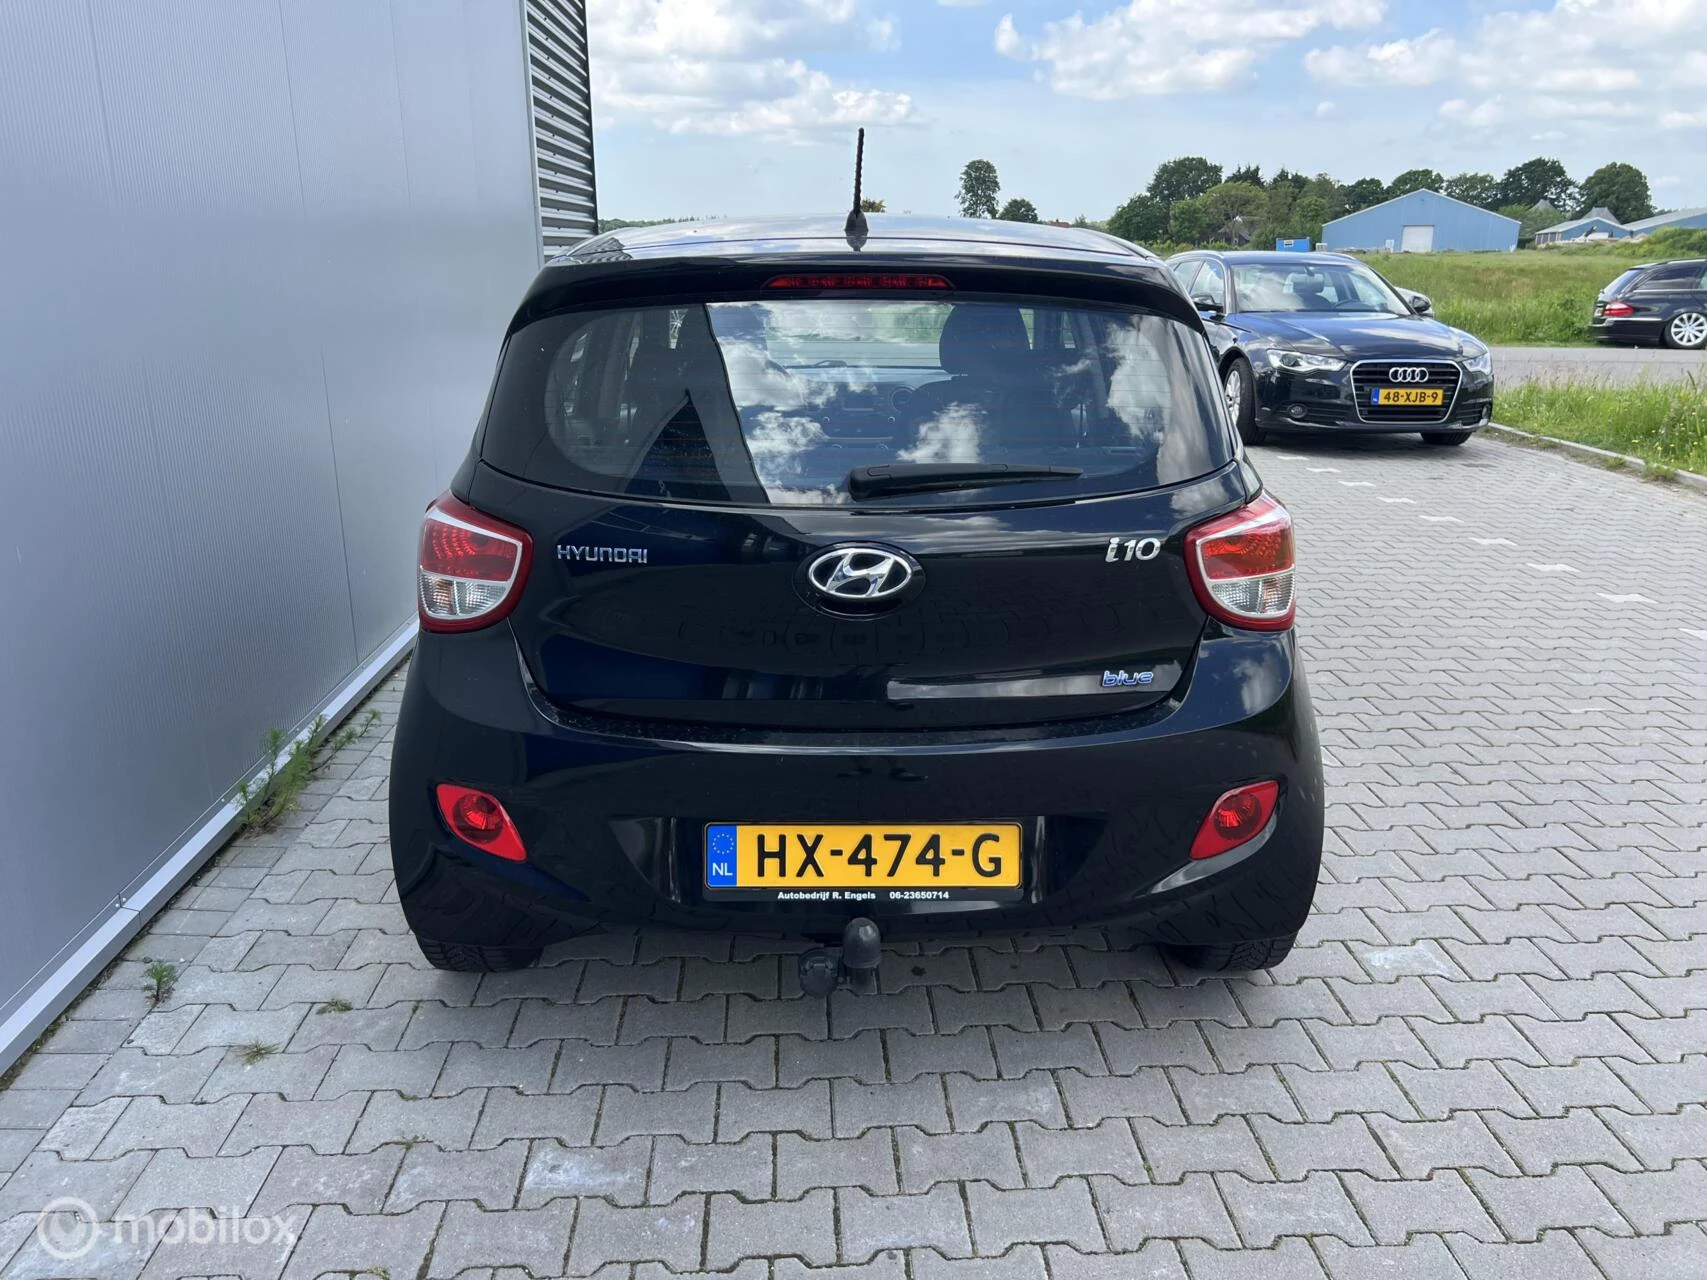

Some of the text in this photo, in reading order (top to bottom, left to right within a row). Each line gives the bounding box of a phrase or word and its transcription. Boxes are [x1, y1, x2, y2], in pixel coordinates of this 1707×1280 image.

[1384, 391, 1439, 403] 48-XJB-9
[557, 545, 648, 564] HYUNDAI
[1105, 537, 1161, 562] i10
[1102, 670, 1153, 687] blue
[756, 834, 1002, 878] HX-474-G
[712, 863, 733, 876] NL
[777, 891, 949, 900] Autobedrijf R. Engels 06-23650714
